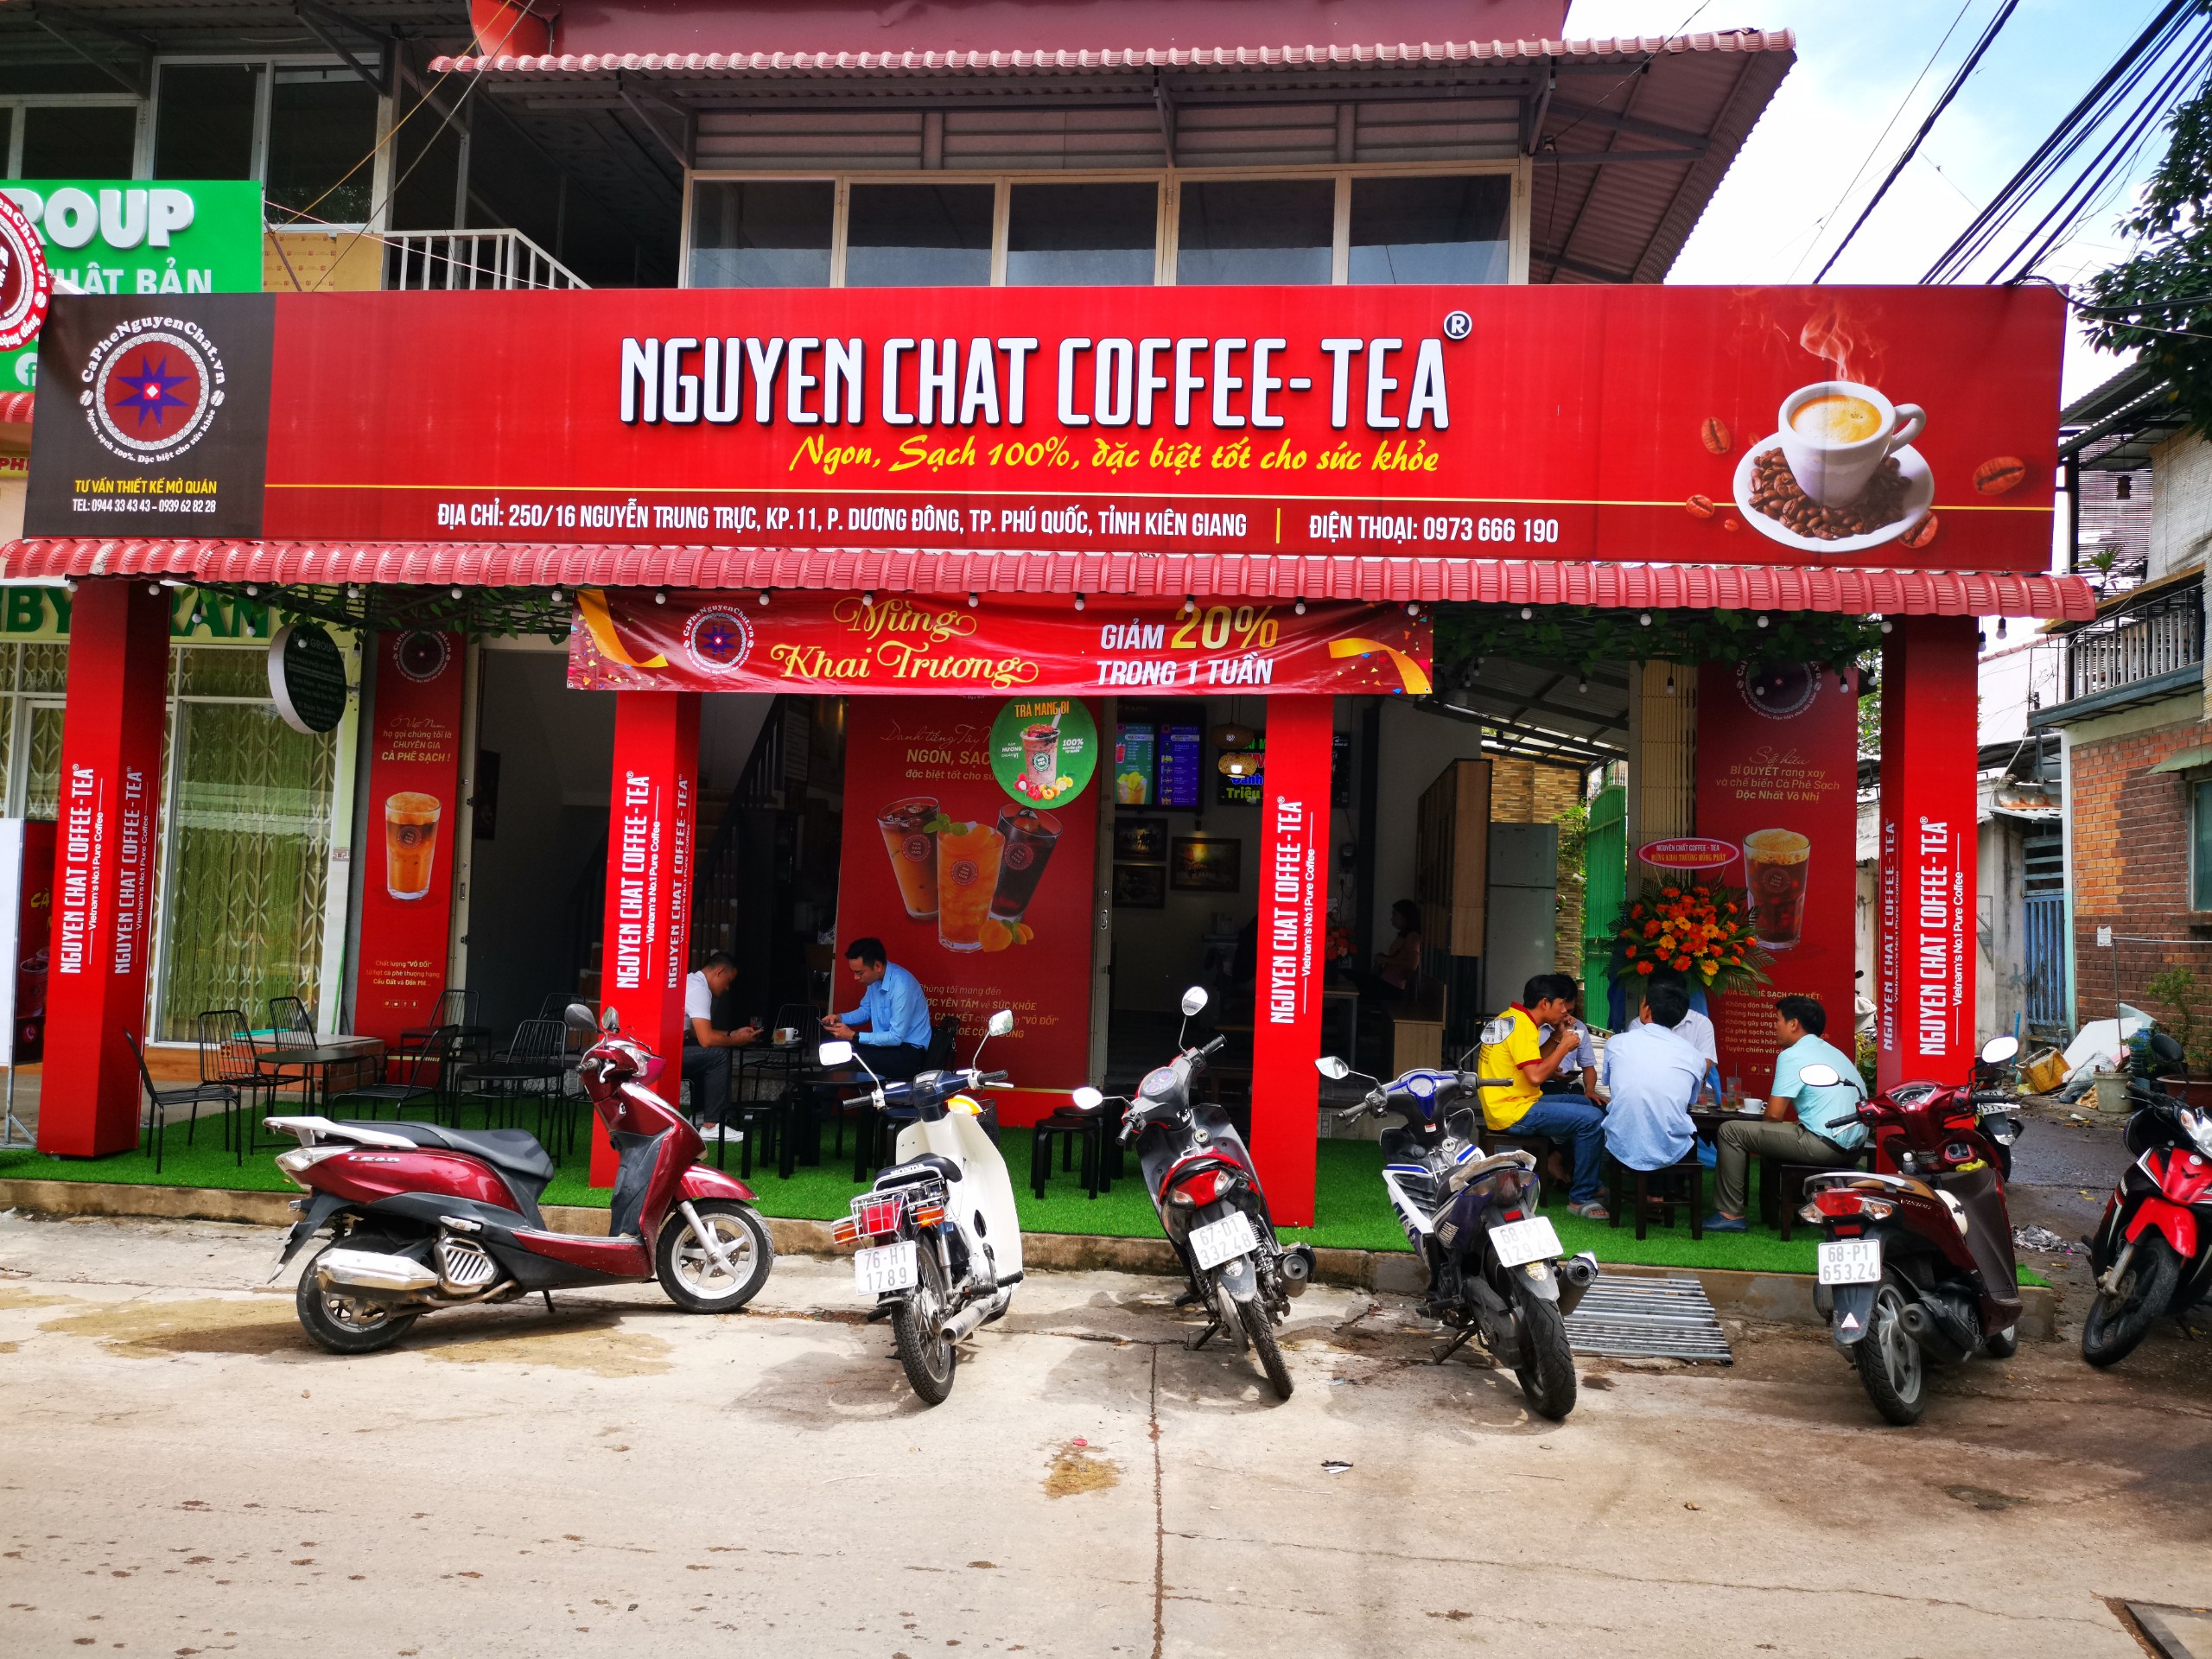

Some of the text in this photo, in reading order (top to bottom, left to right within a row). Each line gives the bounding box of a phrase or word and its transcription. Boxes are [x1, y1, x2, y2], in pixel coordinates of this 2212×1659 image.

[137, 257, 212, 294] BẢN
[81, 316, 226, 384] CaPheNguyenChat.vn
[620, 337, 864, 425] NGUYEN
[882, 337, 1039, 427] CHAT
[156, 452, 175, 462] biệt
[175, 443, 190, 455] cho
[189, 430, 204, 446] sức
[788, 434, 1439, 476] Ngon, Sạch 100%, đặc biệt tốt cho sức khỏe
[75, 477, 217, 494] TƯ VẤN THIẾT KẾ MỞ QUÁN
[73, 499, 216, 512] TEL: 0944 33 43 43 0939 62 82 28
[437, 504, 467, 531] ĐỊA
[470, 497, 504, 526] CHỈ:
[508, 504, 575, 528] 250/16
[580, 497, 648, 529] NGUYỄN
[653, 505, 709, 529] TRUNG
[713, 505, 761, 534] TRỰC,
[827, 508, 844, 530] P.
[849, 506, 906, 531] DƯƠNG
[912, 506, 964, 535] ĐÔNG,
[969, 510, 996, 533] TP.
[1001, 505, 1036, 533] PHÚ
[1040, 504, 1093, 536] QUỐC,
[1097, 504, 1141, 536] TỈNH
[1145, 508, 1187, 536] KIÊN
[1192, 513, 1247, 537] GIANG
[1309, 511, 1559, 545] ĐIỆN THOẠI: 0973 666 190
[683, 605, 753, 638] CaPheNguyenChat.vn
[1100, 606, 1279, 650] GIẢM 20%
[770, 643, 872, 679] Khai
[1096, 653, 1273, 685] TRONG 1 TUẦN
[1014, 701, 1070, 718] TRÀ MANG ĐI
[381, 750, 445, 764] CÀ PHÊ SẠCH
[906, 749, 990, 768] NGON, SẠC
[1743, 764, 1779, 777] QUYẾT
[1782, 769, 1804, 779] rang
[1808, 770, 1825, 779] xay
[906, 769, 924, 780] đặc
[925, 769, 944, 781] biệt
[963, 771, 982, 780] cho
[1751, 777, 1773, 788] biến
[1776, 779, 1789, 788] Cà
[1791, 779, 1811, 789] Phê
[1814, 780, 1840, 791] Sạch
[1736, 789, 1820, 804] Độc Nhất Vô Nhị
[94, 812, 103, 842] Coffee
[652, 821, 660, 852] Coffee
[92, 843, 101, 865] Pure
[649, 853, 658, 876] Pure
[1306, 849, 1315, 880] Coffee
[65, 867, 87, 907] CHAT
[119, 868, 136, 908] CHAT
[620, 877, 644, 919] CHAT
[671, 880, 683, 919] CHAT
[1305, 883, 1313, 906] Pure
[1954, 871, 1963, 904] Coffee
[1274, 907, 1298, 950] CHAT
[1953, 908, 1963, 931] Pure
[60, 912, 85, 974] NGUYEN
[115, 912, 133, 974] NGUYEN
[617, 923, 641, 988] NGUYEN
[668, 925, 679, 988] NGUYEN
[1920, 934, 1947, 979] CHAT
[961, 997, 979, 1008] TÂM
[1270, 956, 1296, 1024] NGUYEN
[1919, 984, 1946, 1056] NGUYEN
[1199, 1218, 1240, 1246] 67-D1
[1499, 1221, 1542, 1245] 68-P1
[864, 1246, 907, 1270] 76-H1
[1200, 1232, 1252, 1265] 332.48
[1827, 1244, 1868, 1262] 68-P1
[867, 1267, 907, 1291] 1789
[1823, 1262, 1877, 1281] 653.24
